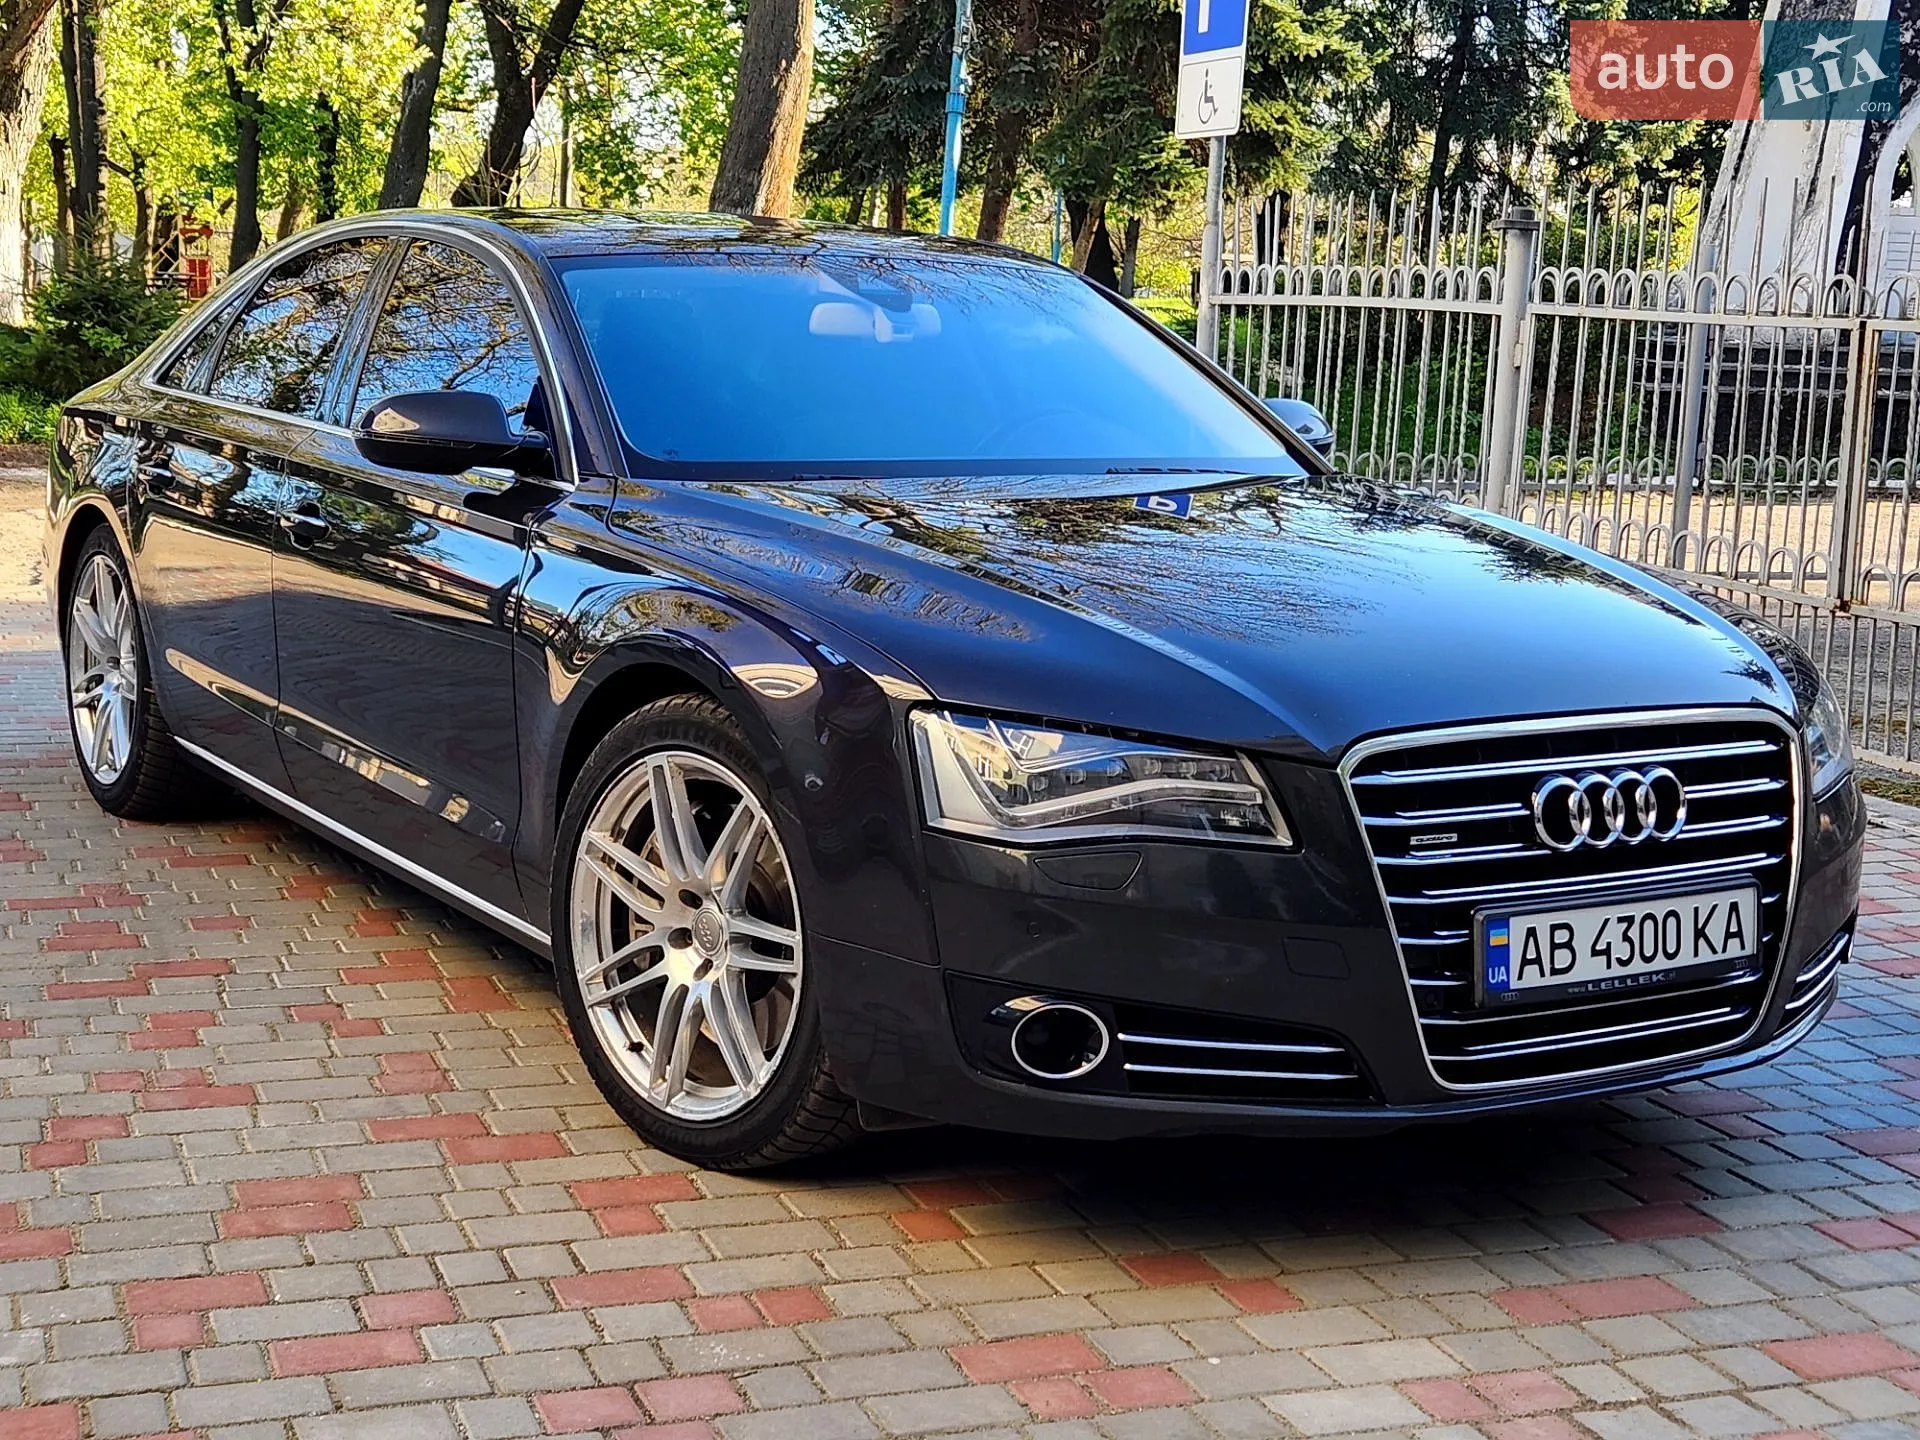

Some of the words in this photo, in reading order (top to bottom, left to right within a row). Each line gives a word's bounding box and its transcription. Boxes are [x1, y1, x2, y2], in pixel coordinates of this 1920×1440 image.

[1516, 921, 1578, 981] AB
[1590, 908, 1682, 970] 4300
[1693, 900, 1746, 958] KA
[1488, 967, 1508, 984] UA
